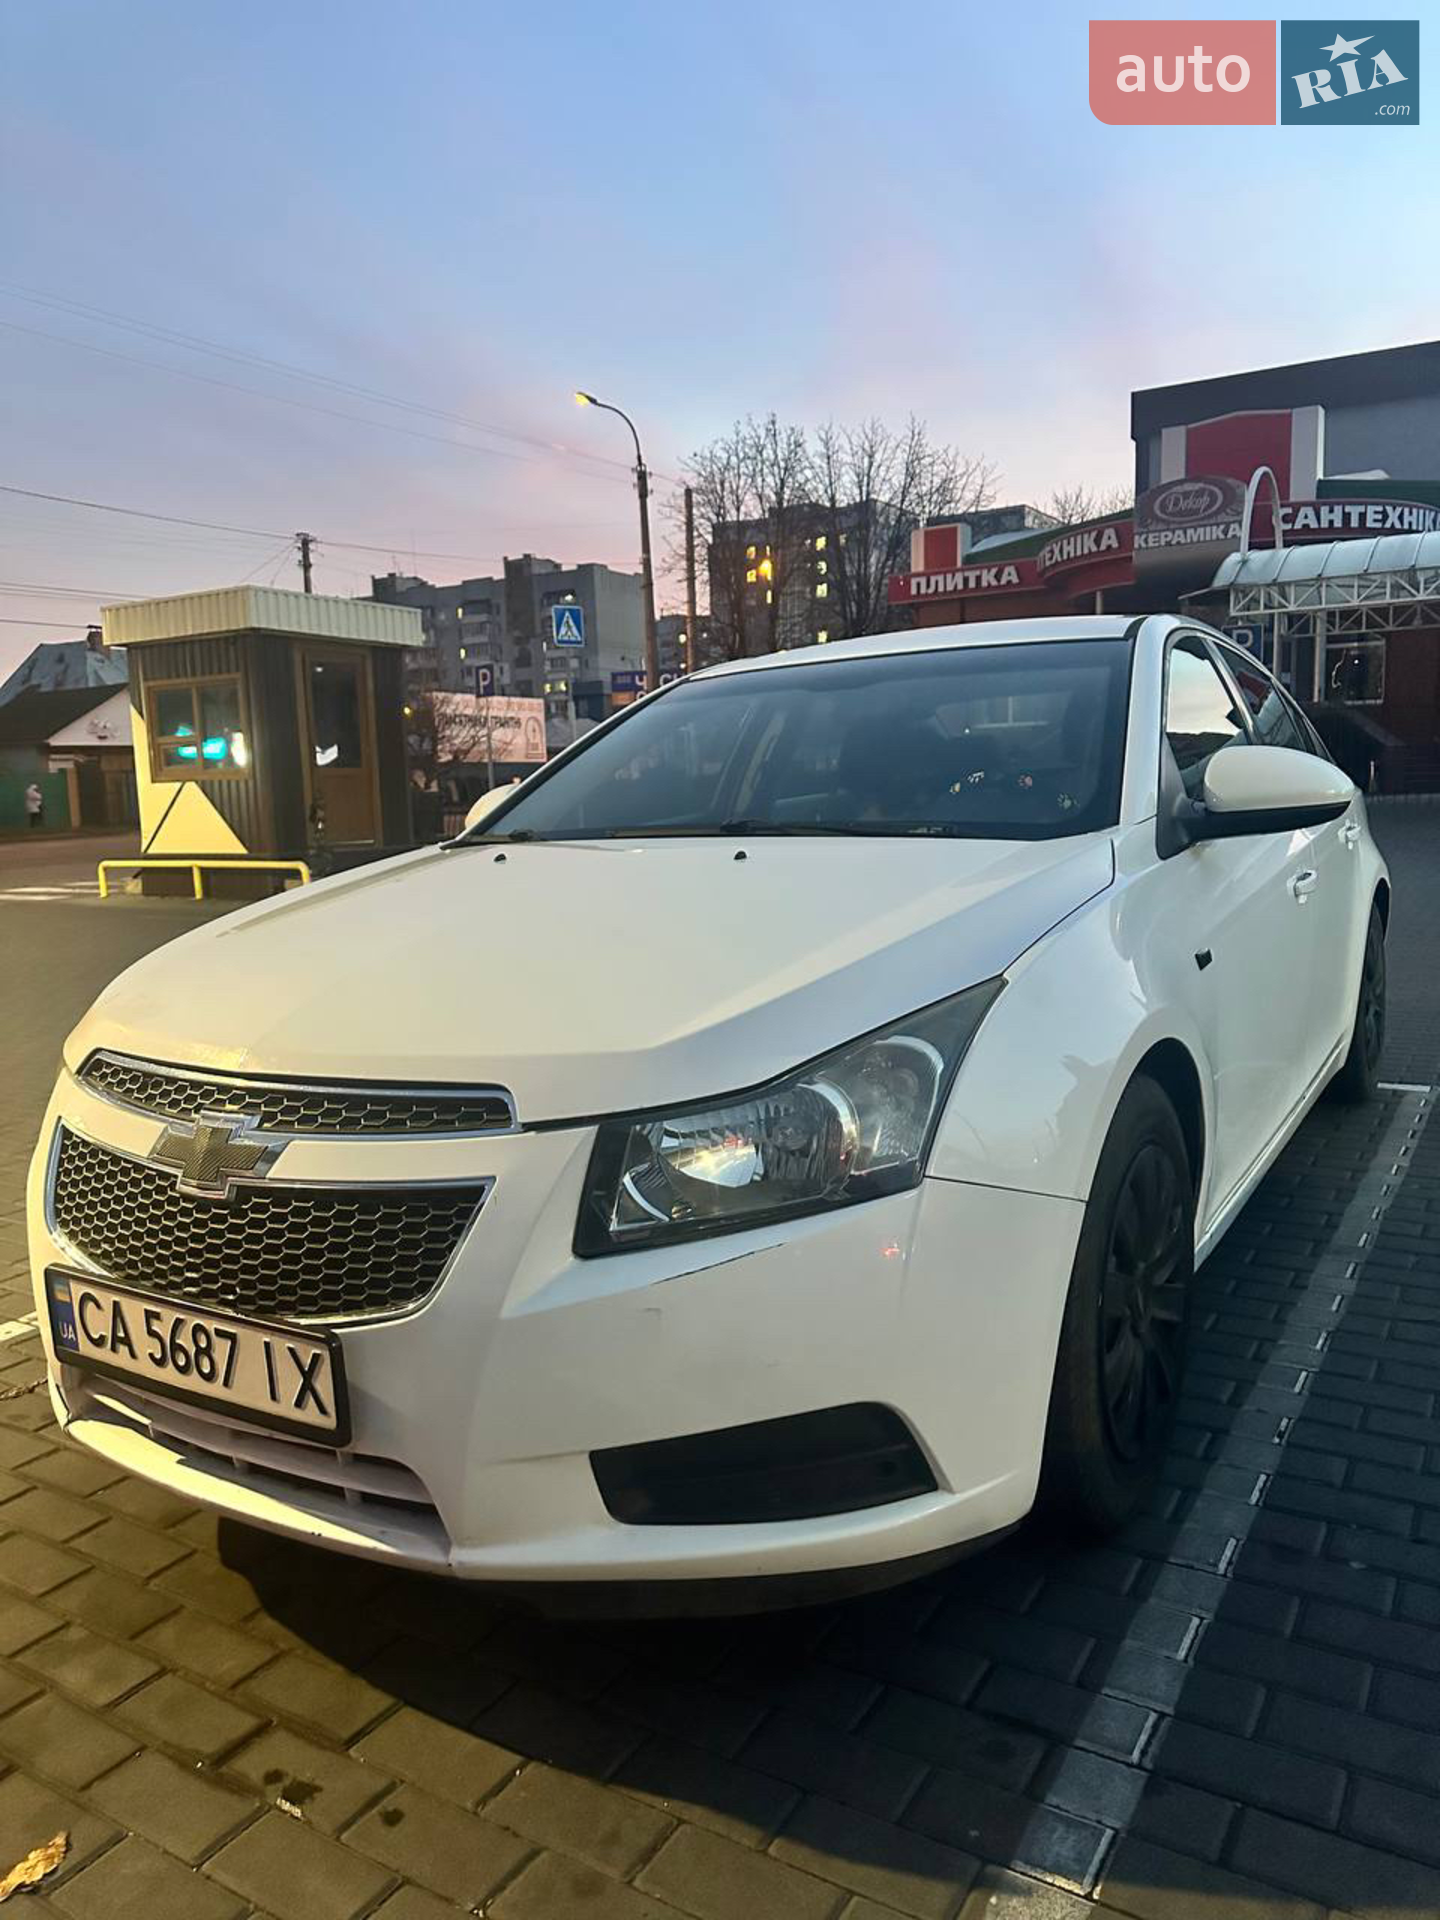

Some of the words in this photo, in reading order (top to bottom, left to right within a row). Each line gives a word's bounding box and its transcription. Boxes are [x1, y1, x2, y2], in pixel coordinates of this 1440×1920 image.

[1037, 527, 1119, 572] ТЕХНІКА
[1133, 521, 1242, 549] КЕРАМІКА
[910, 564, 1020, 596] ПЛИТКА
[479, 668, 491, 696] P
[59, 1322, 76, 1341] UA
[78, 1291, 138, 1360] CA
[143, 1308, 238, 1389] 5687
[263, 1338, 330, 1417] IX
